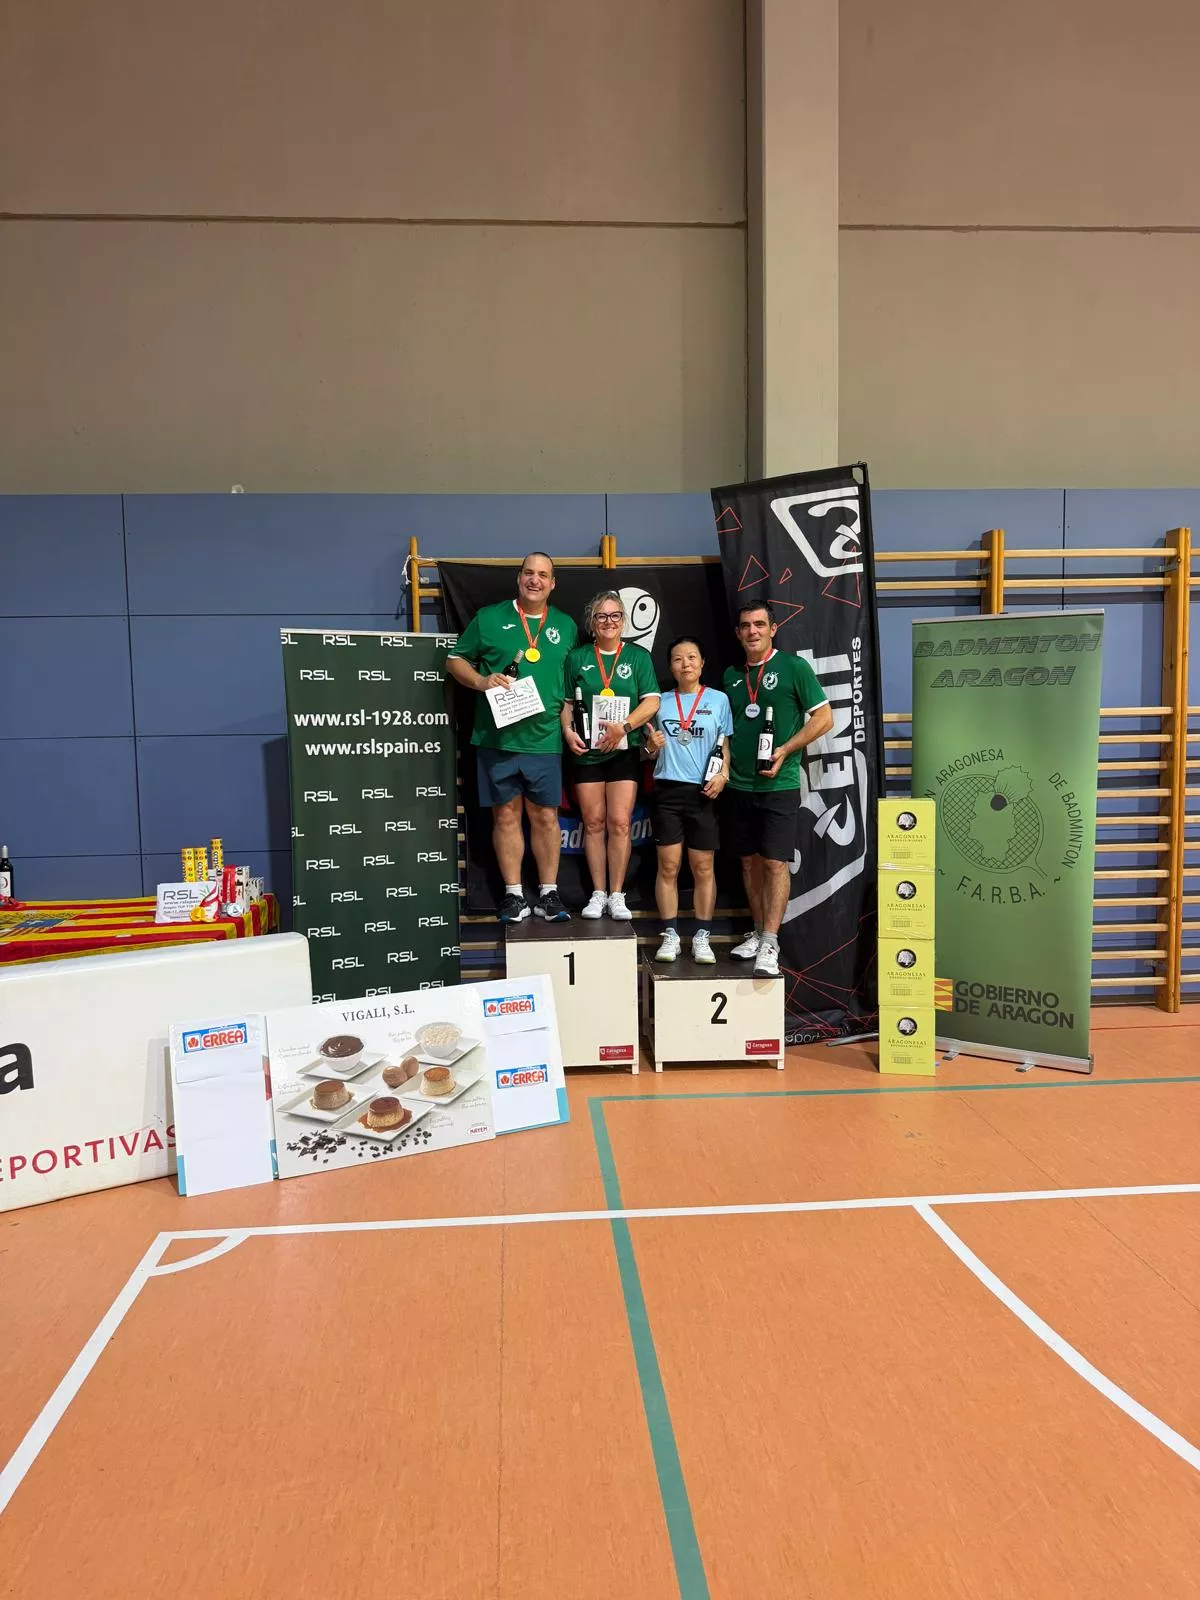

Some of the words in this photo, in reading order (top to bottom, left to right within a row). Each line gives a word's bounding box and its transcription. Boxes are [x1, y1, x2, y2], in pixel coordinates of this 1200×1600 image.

[281, 634, 298, 645] SL
[323, 635, 356, 646] RSL
[381, 637, 412, 647] RSL
[436, 638, 457, 648] RS
[913, 633, 1101, 657] BADMINTON
[300, 669, 334, 681] RSL
[358, 670, 391, 681] RSL
[414, 671, 444, 682] RSL
[930, 666, 1077, 688] ARAGON
[494, 689, 524, 704] RSL
[852, 637, 866, 743] DEPORTES
[294, 709, 449, 726] www.rsl-1928.com
[305, 739, 441, 757] www.rslspain.es
[936, 748, 1004, 786] ARAGONESA
[304, 791, 338, 802] RSL
[362, 788, 393, 799] RSL
[416, 786, 446, 797] RSL
[329, 823, 362, 835] RSL
[385, 820, 416, 832] RSL
[439, 818, 458, 829] RS
[1048, 772, 1067, 791] DE
[1062, 791, 1083, 869] BADMINTON
[306, 858, 340, 870] RSL
[363, 854, 395, 867] RSL
[417, 851, 447, 863] RSL
[163, 890, 198, 900] RSL
[331, 890, 364, 903] RSL
[386, 886, 417, 898] RSL
[440, 882, 459, 894] RS
[308, 926, 341, 939] RSL
[365, 921, 396, 933] RSL
[418, 915, 449, 928] RSL
[332, 957, 365, 970] RSL
[387, 950, 419, 963] RSL
[440, 945, 460, 957] RS
[564, 951, 576, 985] 1
[955, 980, 1059, 1008] GOBIERNO
[342, 1007, 391, 1023] VIGALI,
[394, 1004, 415, 1017] S.L.
[500, 1000, 532, 1014] ERREA
[711, 992, 727, 1024] 2
[955, 998, 979, 1015] DE
[987, 1003, 1074, 1029] ARAGON
[203, 1030, 244, 1048] ERREA
[513, 1071, 545, 1085] ERREA
[0, 1125, 176, 1181] PORTIVAS
